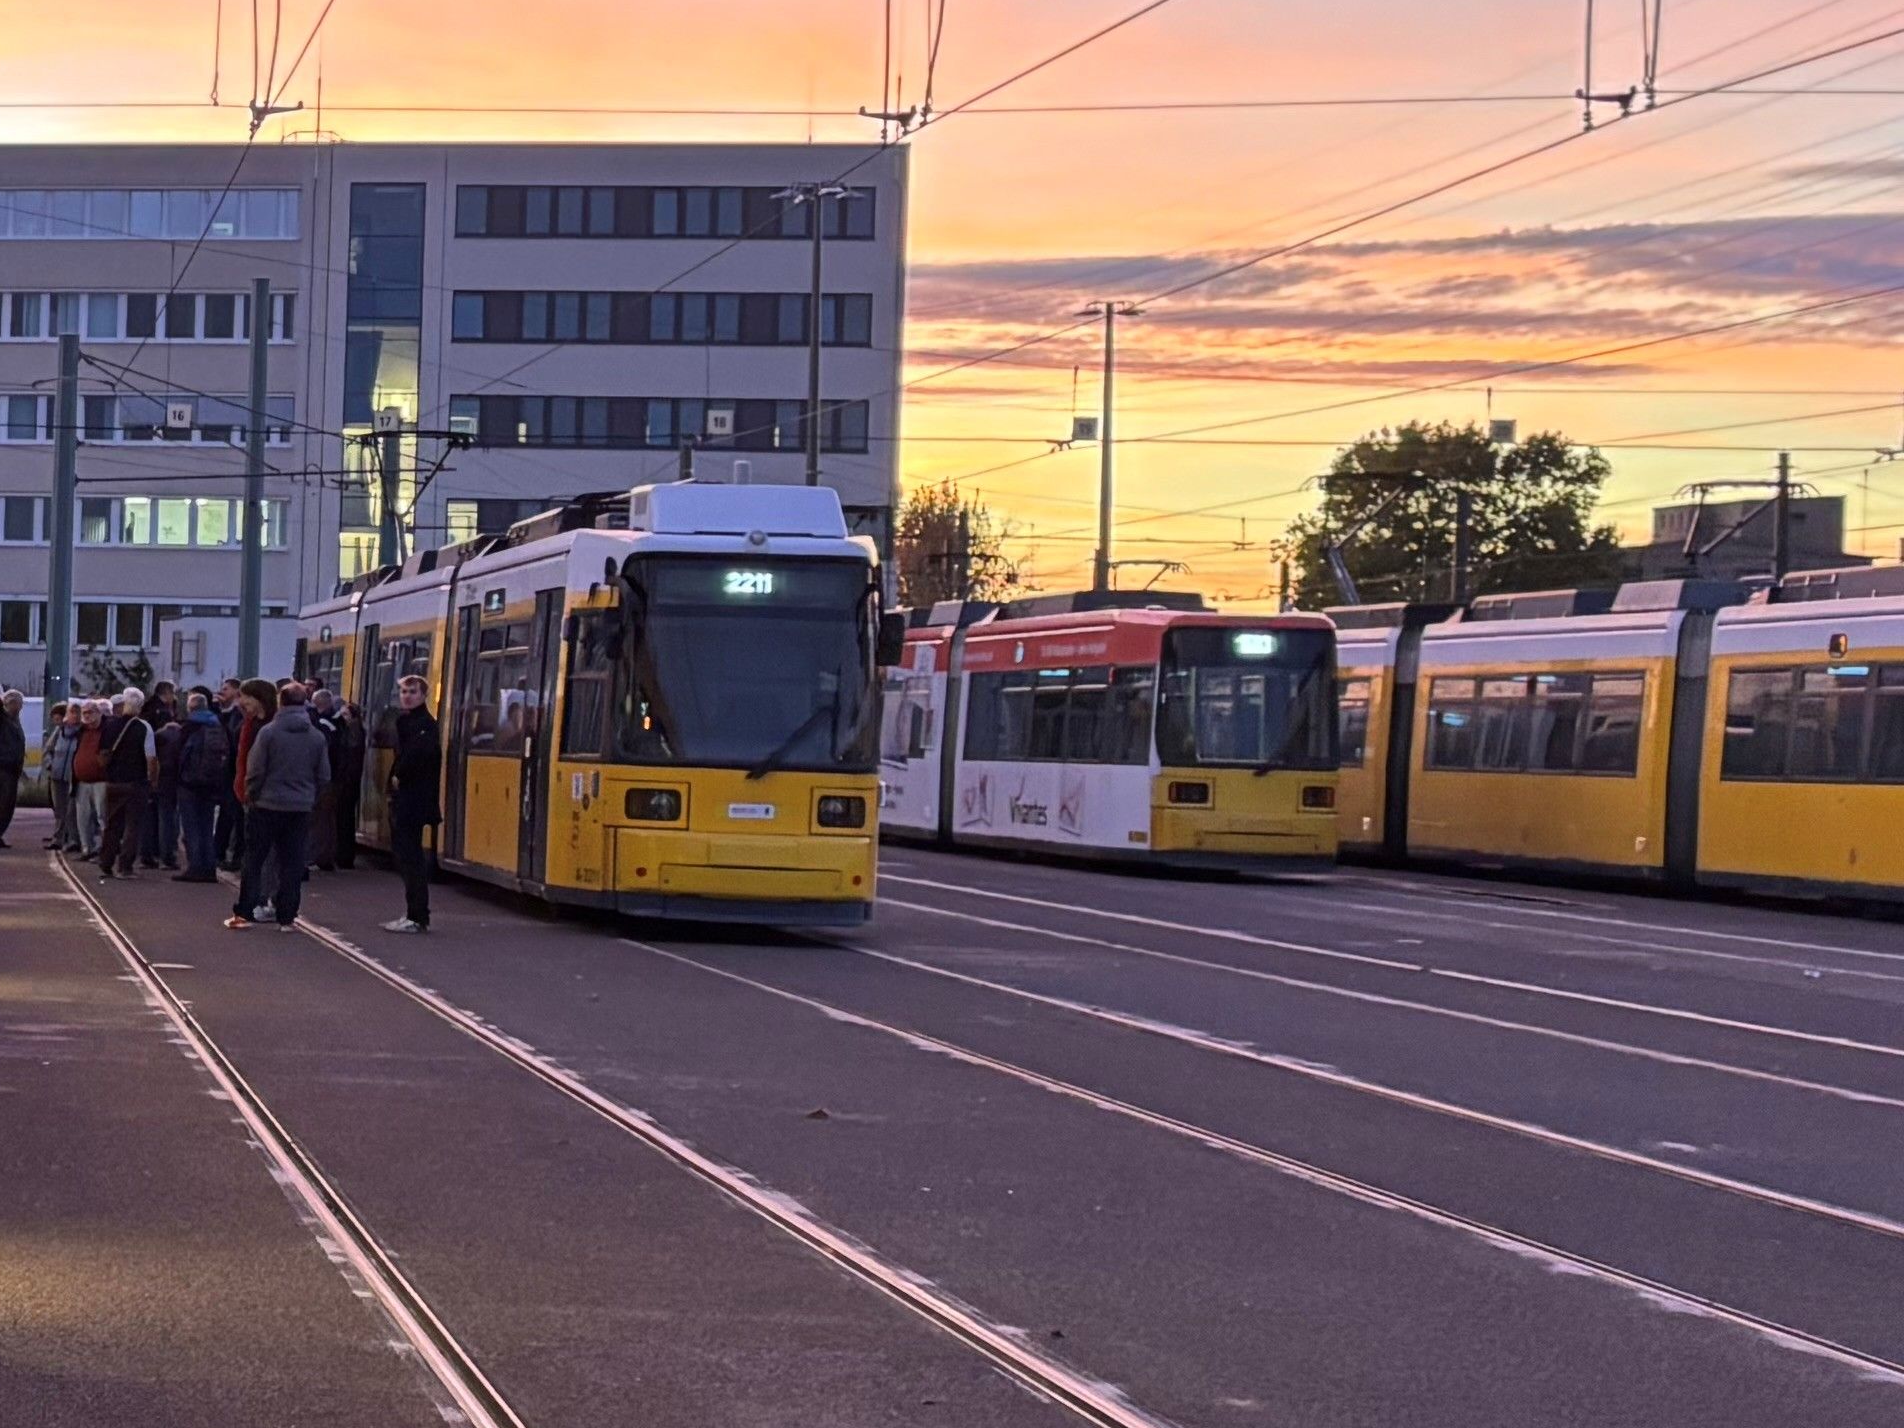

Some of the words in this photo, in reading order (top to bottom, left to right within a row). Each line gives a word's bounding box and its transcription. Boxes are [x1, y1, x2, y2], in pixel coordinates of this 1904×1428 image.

[172, 410, 185, 421] 16
[379, 416, 391, 428] 17
[723, 571, 773, 594] 2211
